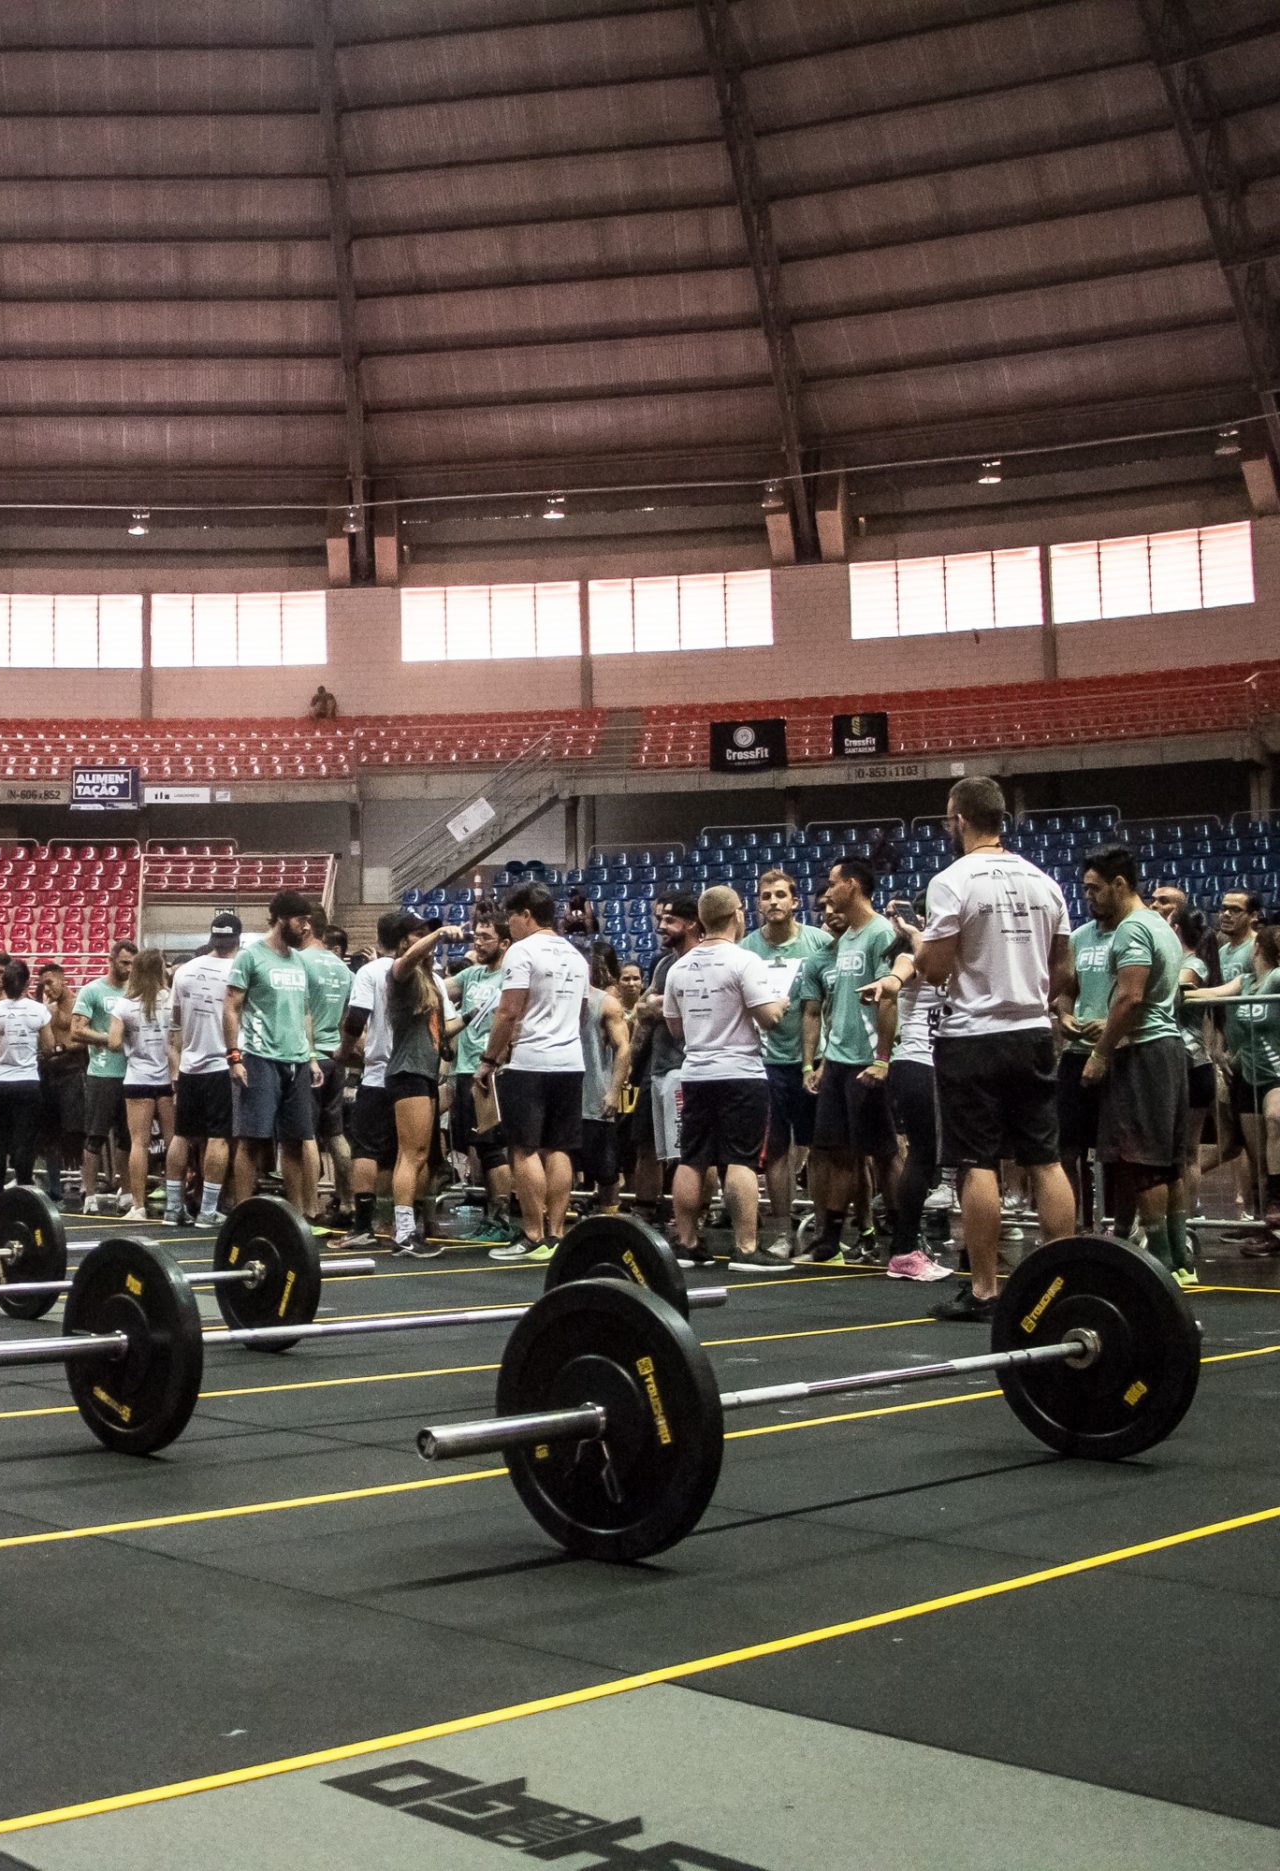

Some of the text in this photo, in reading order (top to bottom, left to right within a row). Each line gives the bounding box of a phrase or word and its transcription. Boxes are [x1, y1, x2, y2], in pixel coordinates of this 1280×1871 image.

[844, 737, 876, 747] CrossFit
[726, 747, 769, 760] CrossFit
[75, 773, 129, 784] ALIMEN-
[75, 782, 120, 798] TAÇÃO
